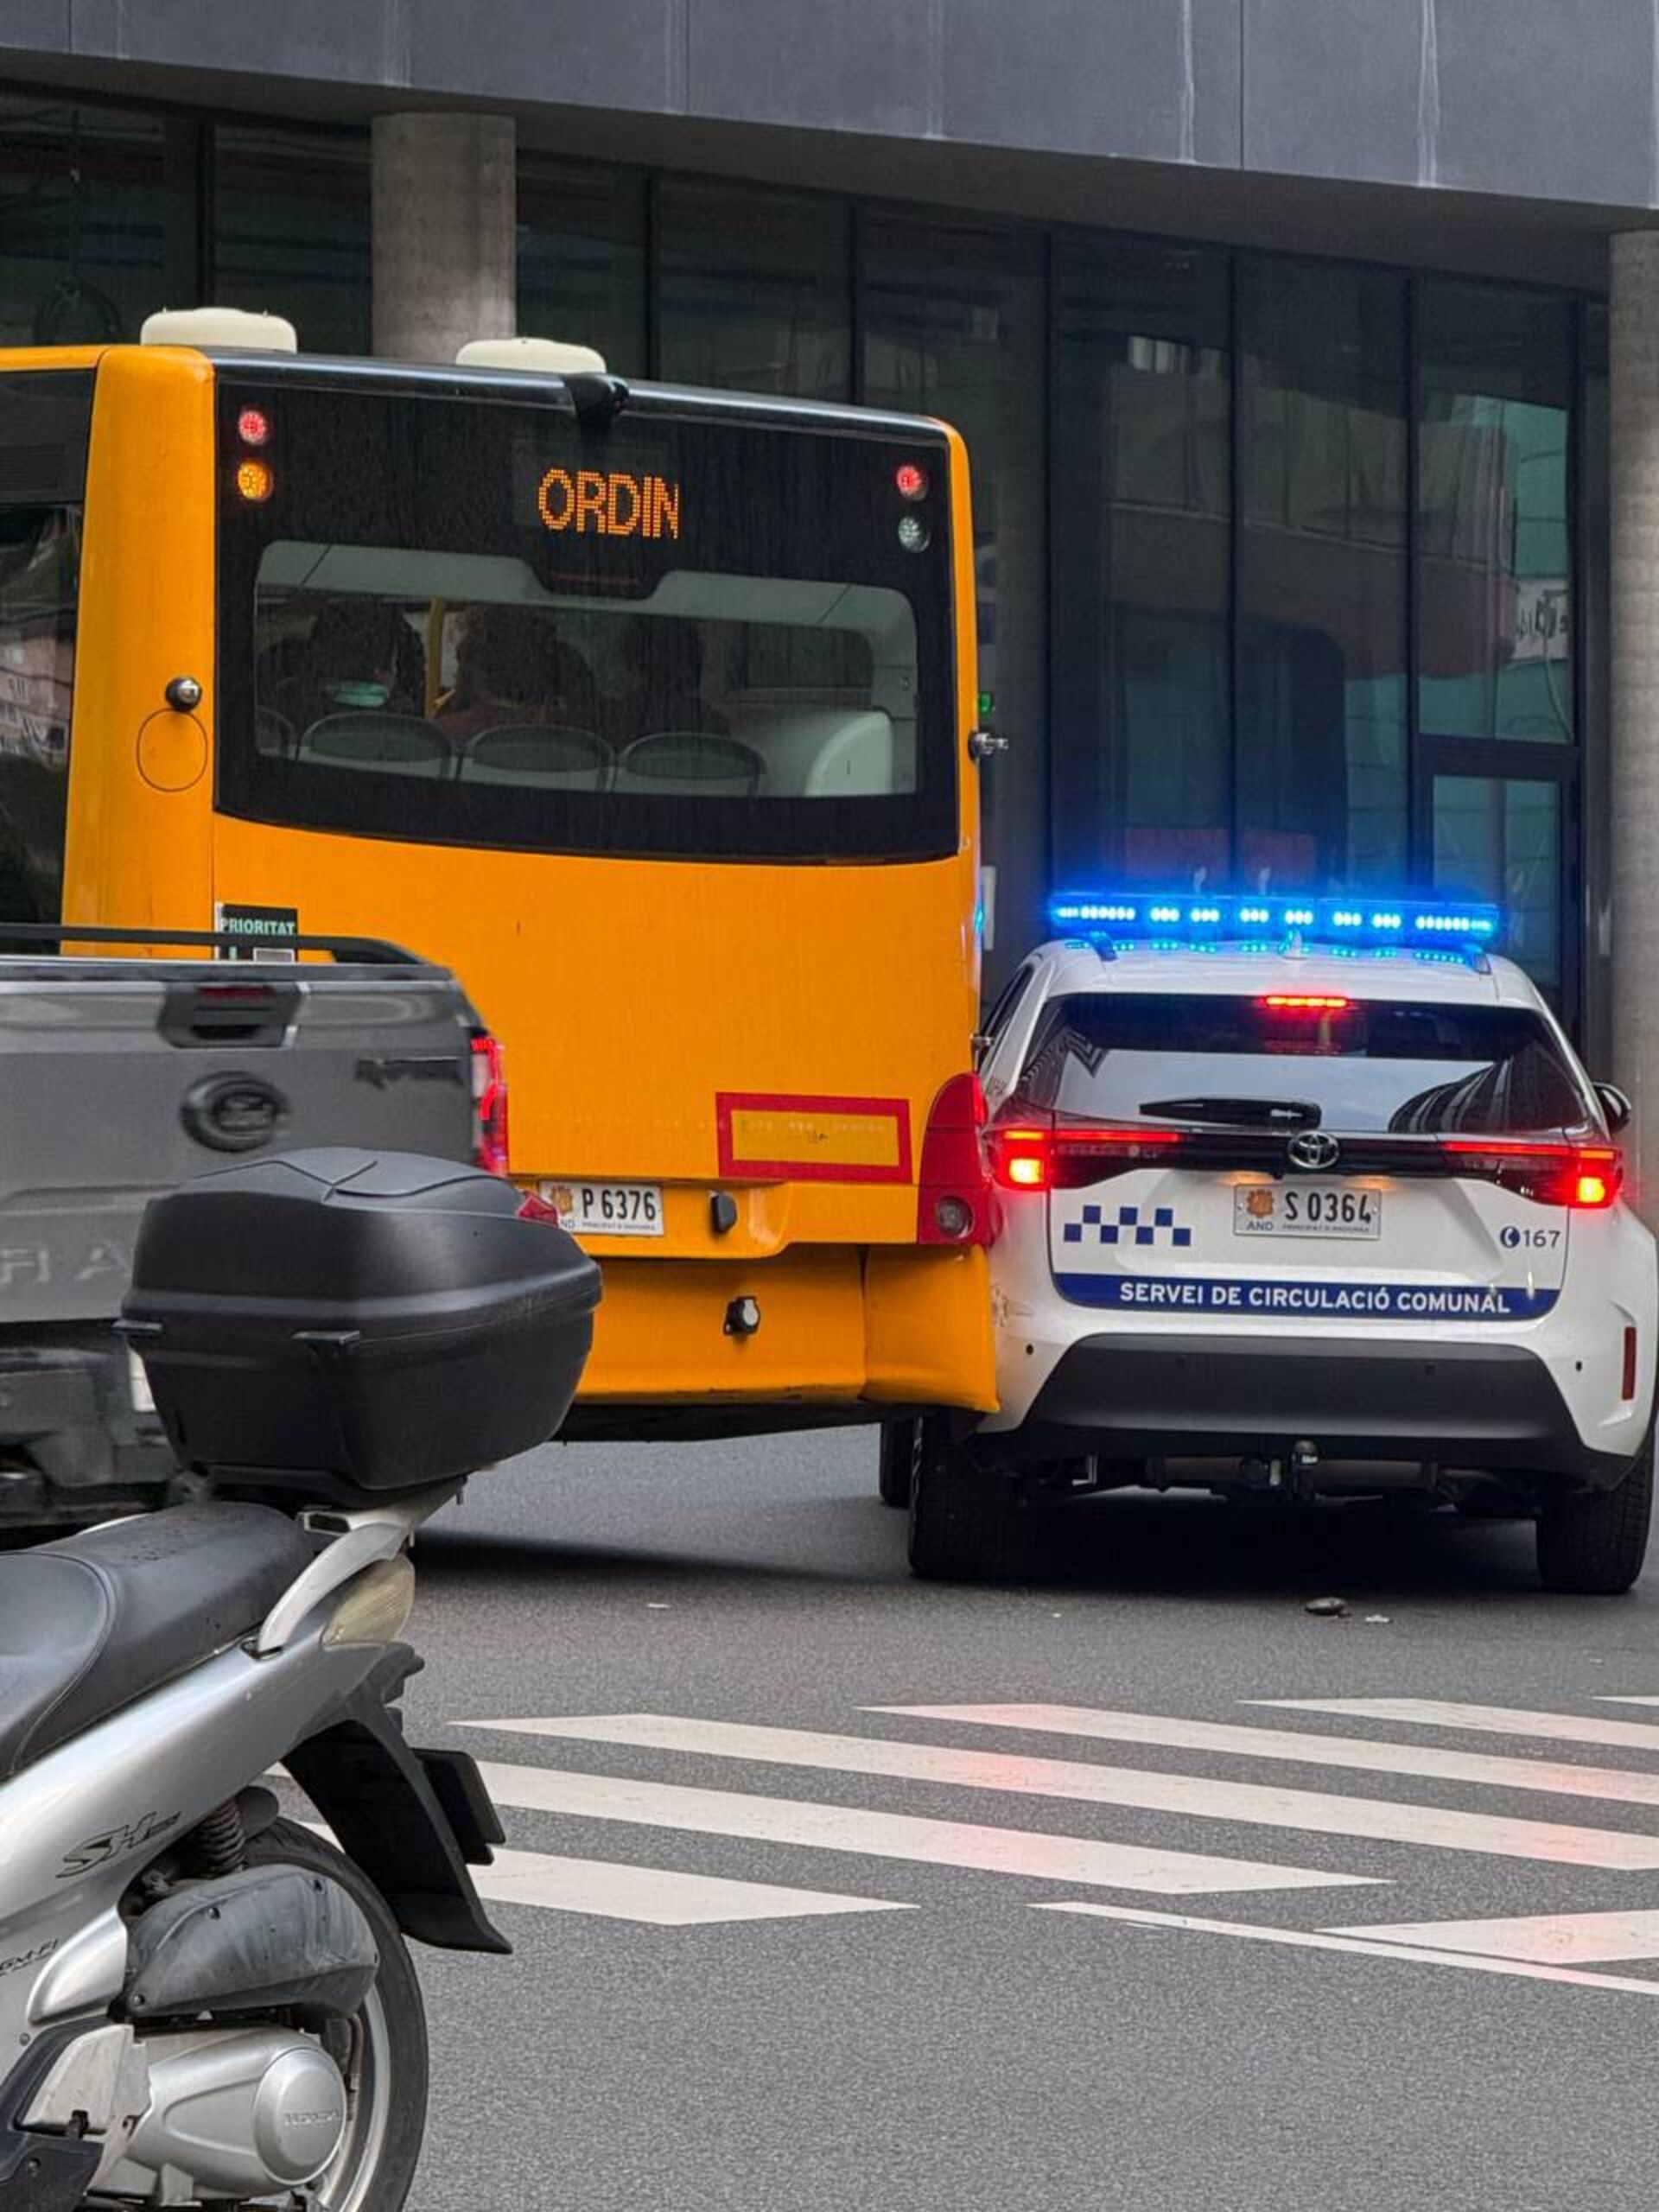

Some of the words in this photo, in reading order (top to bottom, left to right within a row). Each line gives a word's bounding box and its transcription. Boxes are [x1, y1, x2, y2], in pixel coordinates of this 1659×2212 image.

[538, 469, 678, 539] ORDIN
[582, 1188, 594, 1219] P
[601, 1189, 657, 1221] 6376
[1285, 1192, 1299, 1221] S
[1307, 1192, 1372, 1224] 0364
[1246, 1221, 1274, 1231] AND
[1522, 1230, 1561, 1249] 167
[1120, 1282, 1204, 1305] SERVEI
[1211, 1286, 1243, 1306] DE
[1249, 1287, 1390, 1310] CIRCULACIÓ
[1396, 1293, 1510, 1313] COMUNAL
